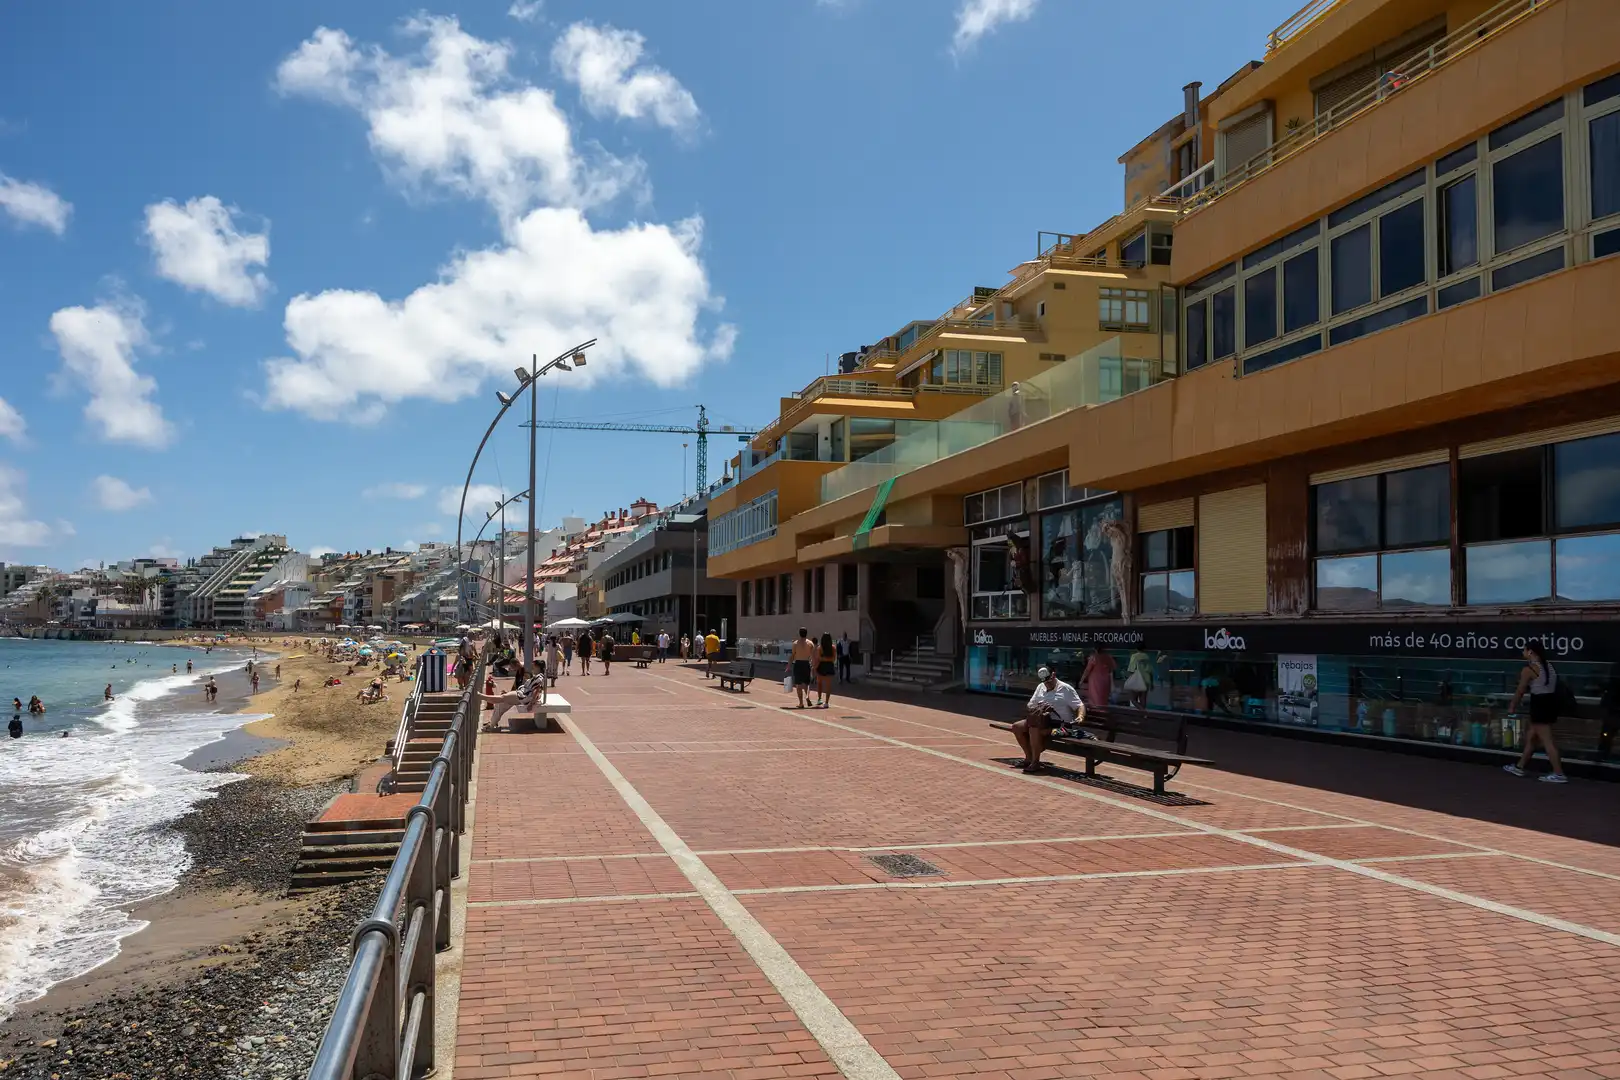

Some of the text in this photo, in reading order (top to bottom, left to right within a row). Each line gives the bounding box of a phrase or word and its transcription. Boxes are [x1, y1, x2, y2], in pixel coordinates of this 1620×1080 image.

[1030, 632, 1058, 642] MUEBLES
[1062, 632, 1089, 643] MENAJE
[1093, 630, 1144, 643] DECORACIÓN
[1369, 631, 1401, 648] más
[1405, 631, 1425, 649] de
[1430, 633, 1452, 649] 40
[1455, 632, 1498, 650] años
[1281, 660, 1314, 673] rebajas
